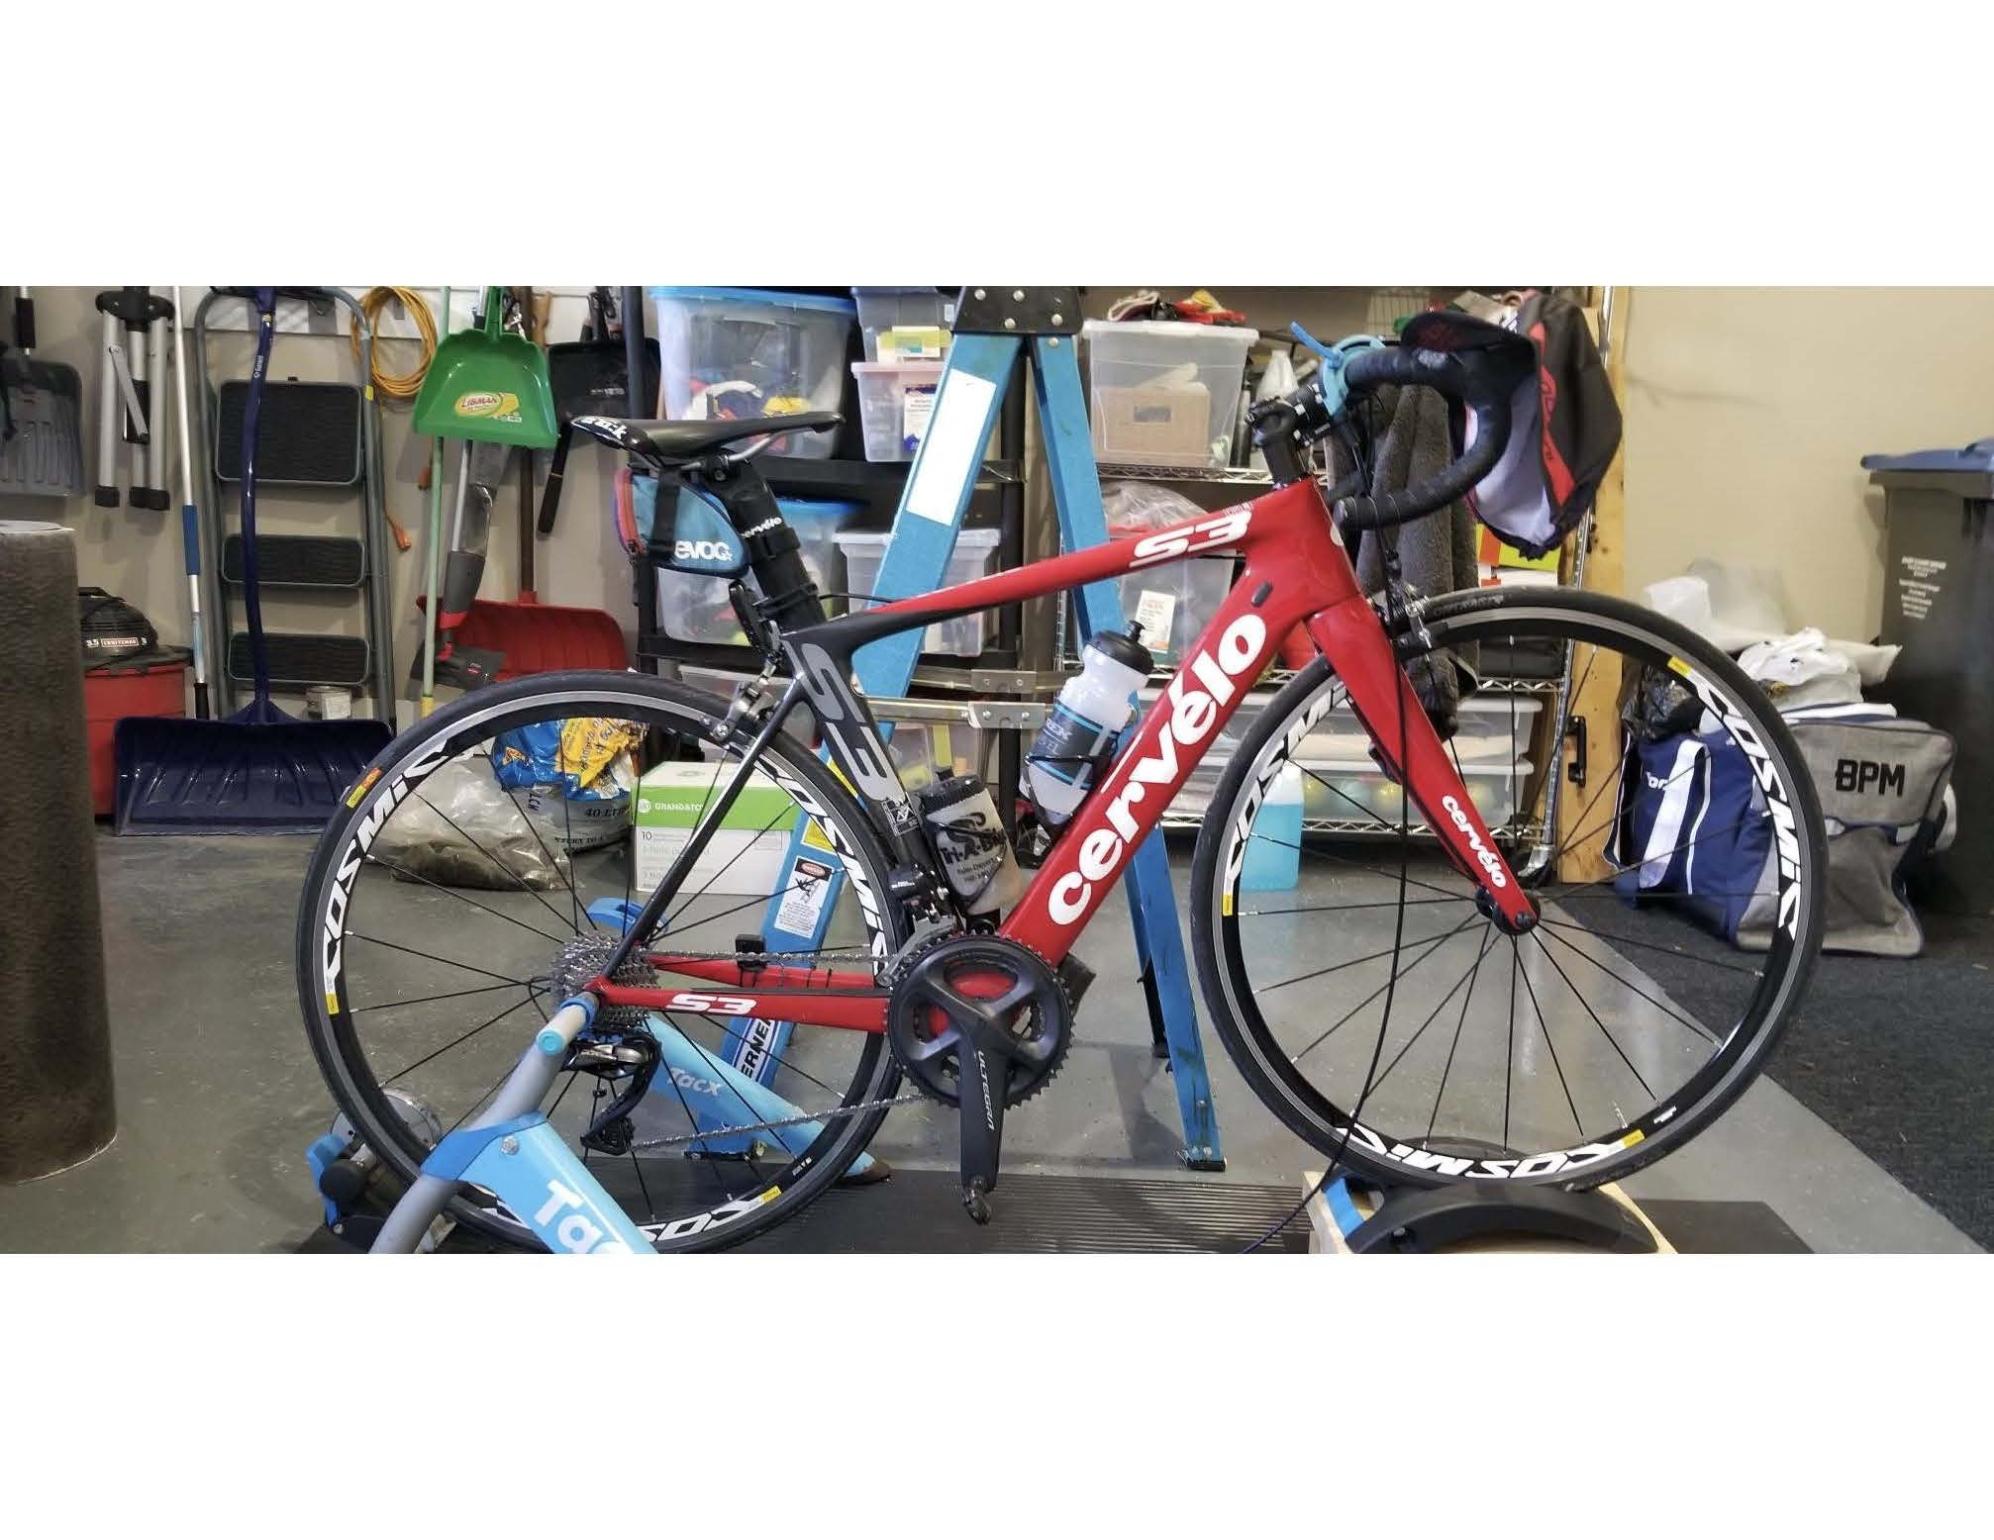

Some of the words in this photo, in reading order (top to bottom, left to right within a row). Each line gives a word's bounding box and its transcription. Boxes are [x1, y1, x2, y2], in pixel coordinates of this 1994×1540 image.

[1129, 510, 1252, 568] S3
[779, 639, 906, 804] S3
[1835, 759, 1905, 797] BPM
[654, 803, 703, 811] GRAND&TO
[641, 831, 652, 840] 10
[666, 993, 757, 1015] S3
[741, 1019, 773, 1079] ERNE
[667, 1067, 722, 1096] Tacx
[978, 1050, 995, 1131] ULTEGRA
